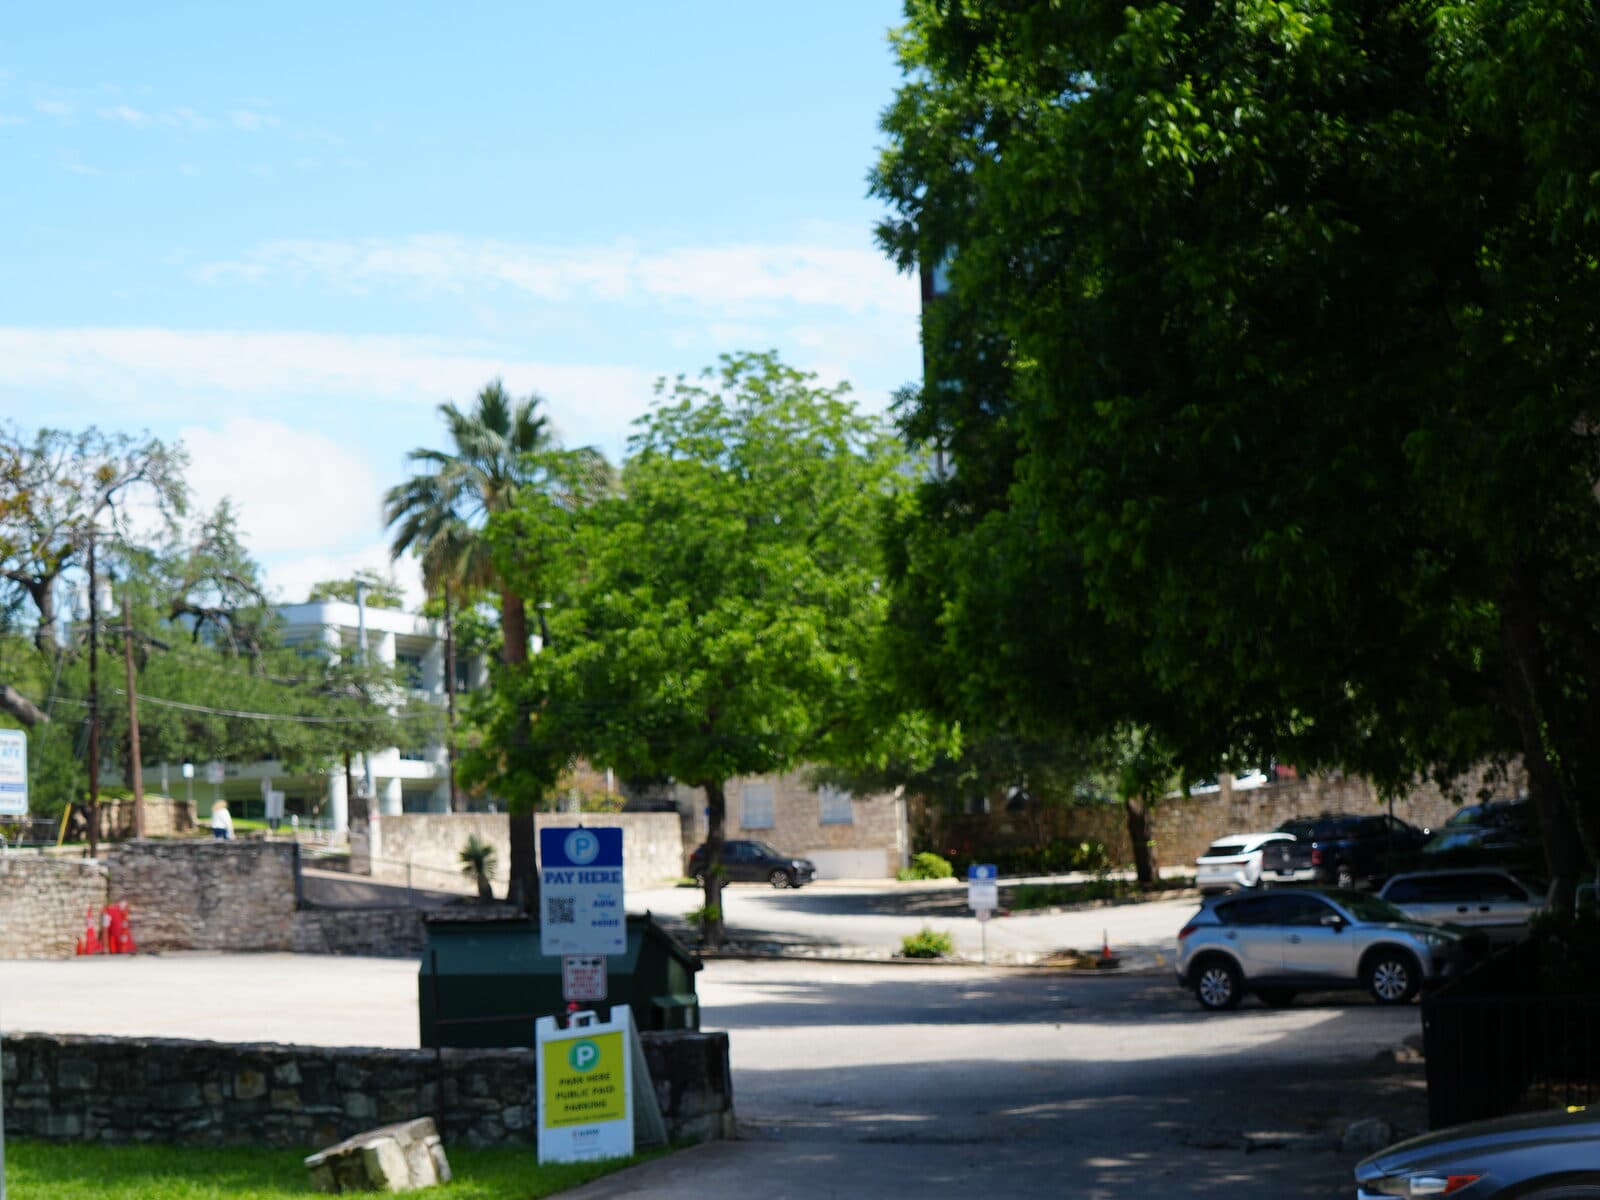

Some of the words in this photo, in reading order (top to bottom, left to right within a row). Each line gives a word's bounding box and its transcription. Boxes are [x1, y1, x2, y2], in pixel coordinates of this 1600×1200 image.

[575, 838, 591, 856] P
[544, 871, 575, 884] PAY
[577, 871, 621, 884] HERE
[577, 1046, 595, 1067] P
[559, 1076, 585, 1086] PARK
[586, 1073, 611, 1082] HERE
[556, 1089, 589, 1099] PUBLIC
[592, 1085, 615, 1095] PAID
[564, 1100, 607, 1112] PARKING
